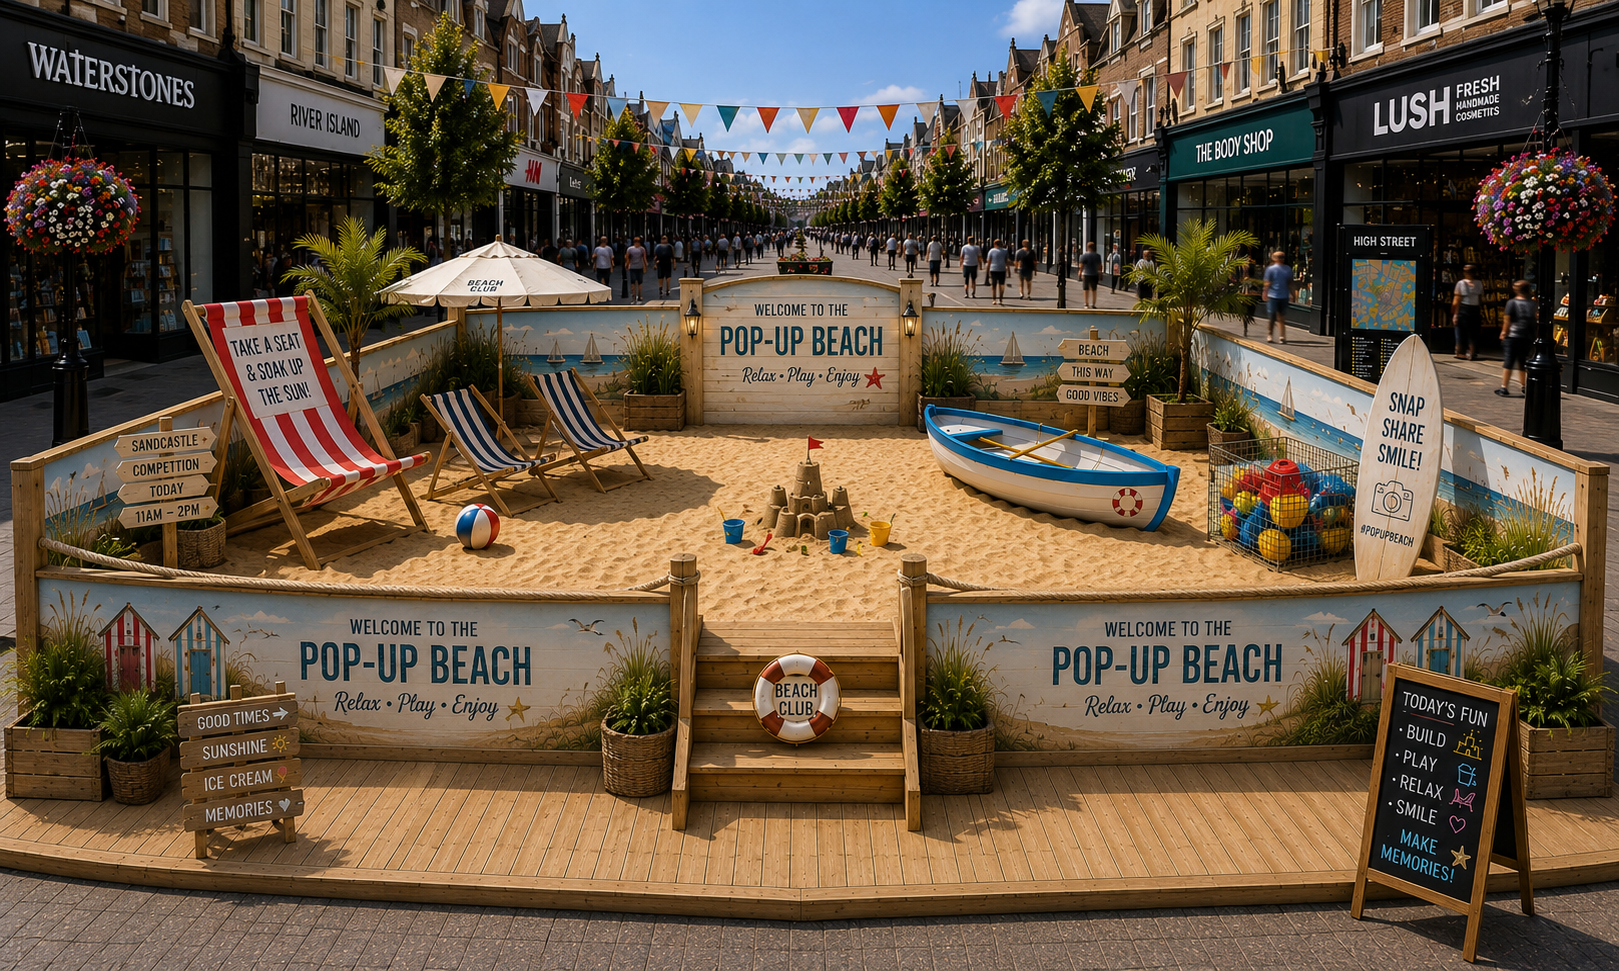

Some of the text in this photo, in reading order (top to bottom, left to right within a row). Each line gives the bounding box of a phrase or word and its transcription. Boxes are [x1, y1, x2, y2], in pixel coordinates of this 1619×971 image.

[27, 41, 195, 109] WATERSTONES
[1456, 75, 1500, 98] FRESH
[1374, 86, 1450, 136] LUSH
[1456, 94, 1500, 111] HANDMADE
[291, 103, 361, 138] RIVER ISLAND
[1195, 128, 1274, 163] THE BODY SHOP
[1353, 236, 1417, 247] HIGH STREET
[754, 303, 848, 317] WELCOME TO THE
[230, 332, 301, 357] TAKE A SEAT
[720, 326, 883, 356] POP-UP BEACH
[1078, 344, 1109, 356] BEACH
[246, 357, 303, 381] & SOAK UP
[742, 366, 861, 388] Relax Play Enjoy
[1072, 366, 1113, 378] THIS WAY
[258, 381, 312, 406] THE SUN!
[1066, 389, 1119, 402] GOOD VIBES
[1389, 391, 1425, 417] SNAP
[132, 434, 198, 452] SANDCASTLE
[1382, 418, 1426, 445] SHARE
[1377, 443, 1422, 471] SMILE!
[149, 482, 184, 498] TODAY
[135, 508, 162, 523] 11AM
[177, 503, 200, 518] 2PM
[350, 618, 478, 637] WELCOME TO THE
[1105, 620, 1232, 637] WELCOME TO THE
[300, 641, 531, 685] POP-UP BEACH
[1052, 643, 1282, 685] POP-UP BEACH
[775, 683, 817, 698] BEACH
[334, 691, 499, 721] Relax Play Enjoy
[779, 701, 813, 716] CLUB
[1085, 693, 1249, 720] Relax Play Enjoy
[1403, 691, 1488, 727] TODAY'S FUN
[197, 709, 270, 730] GOOD TIMES
[1406, 724, 1447, 748] BUILD
[202, 739, 268, 760] SUNSHINE
[1403, 750, 1438, 772] PLAY
[204, 769, 273, 792] ICE CREAM
[1400, 774, 1443, 800] RELAX
[205, 800, 273, 823] MEMORIES
[1396, 799, 1438, 825] SMILE
[1400, 829, 1438, 855] MAKE
[1380, 843, 1455, 883] MEMORIES!
